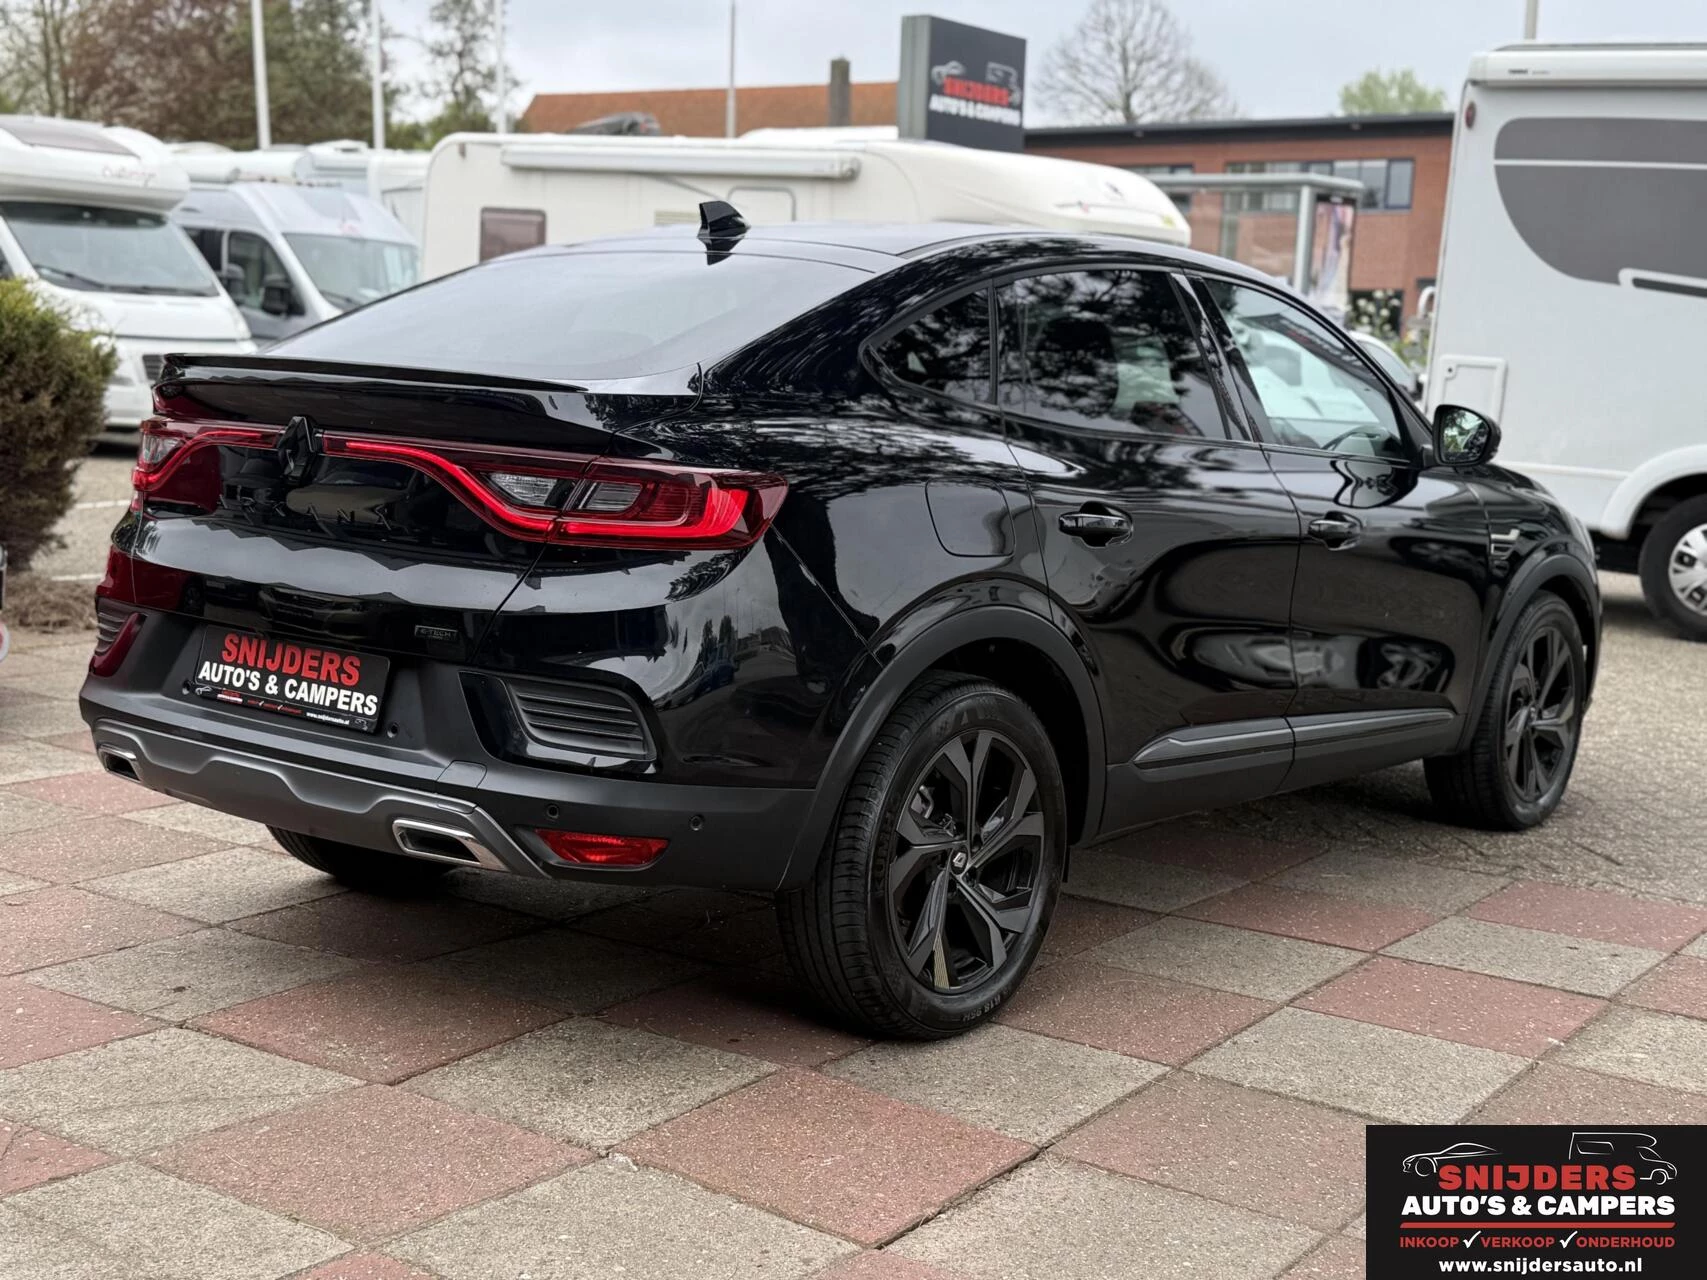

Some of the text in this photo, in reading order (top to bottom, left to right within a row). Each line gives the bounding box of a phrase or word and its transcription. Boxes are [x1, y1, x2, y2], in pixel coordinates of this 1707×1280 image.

[222, 632, 361, 687] SNIJDERS
[198, 660, 261, 692] AUTO'S
[264, 674, 279, 696] &
[284, 678, 379, 716] CAMPERS
